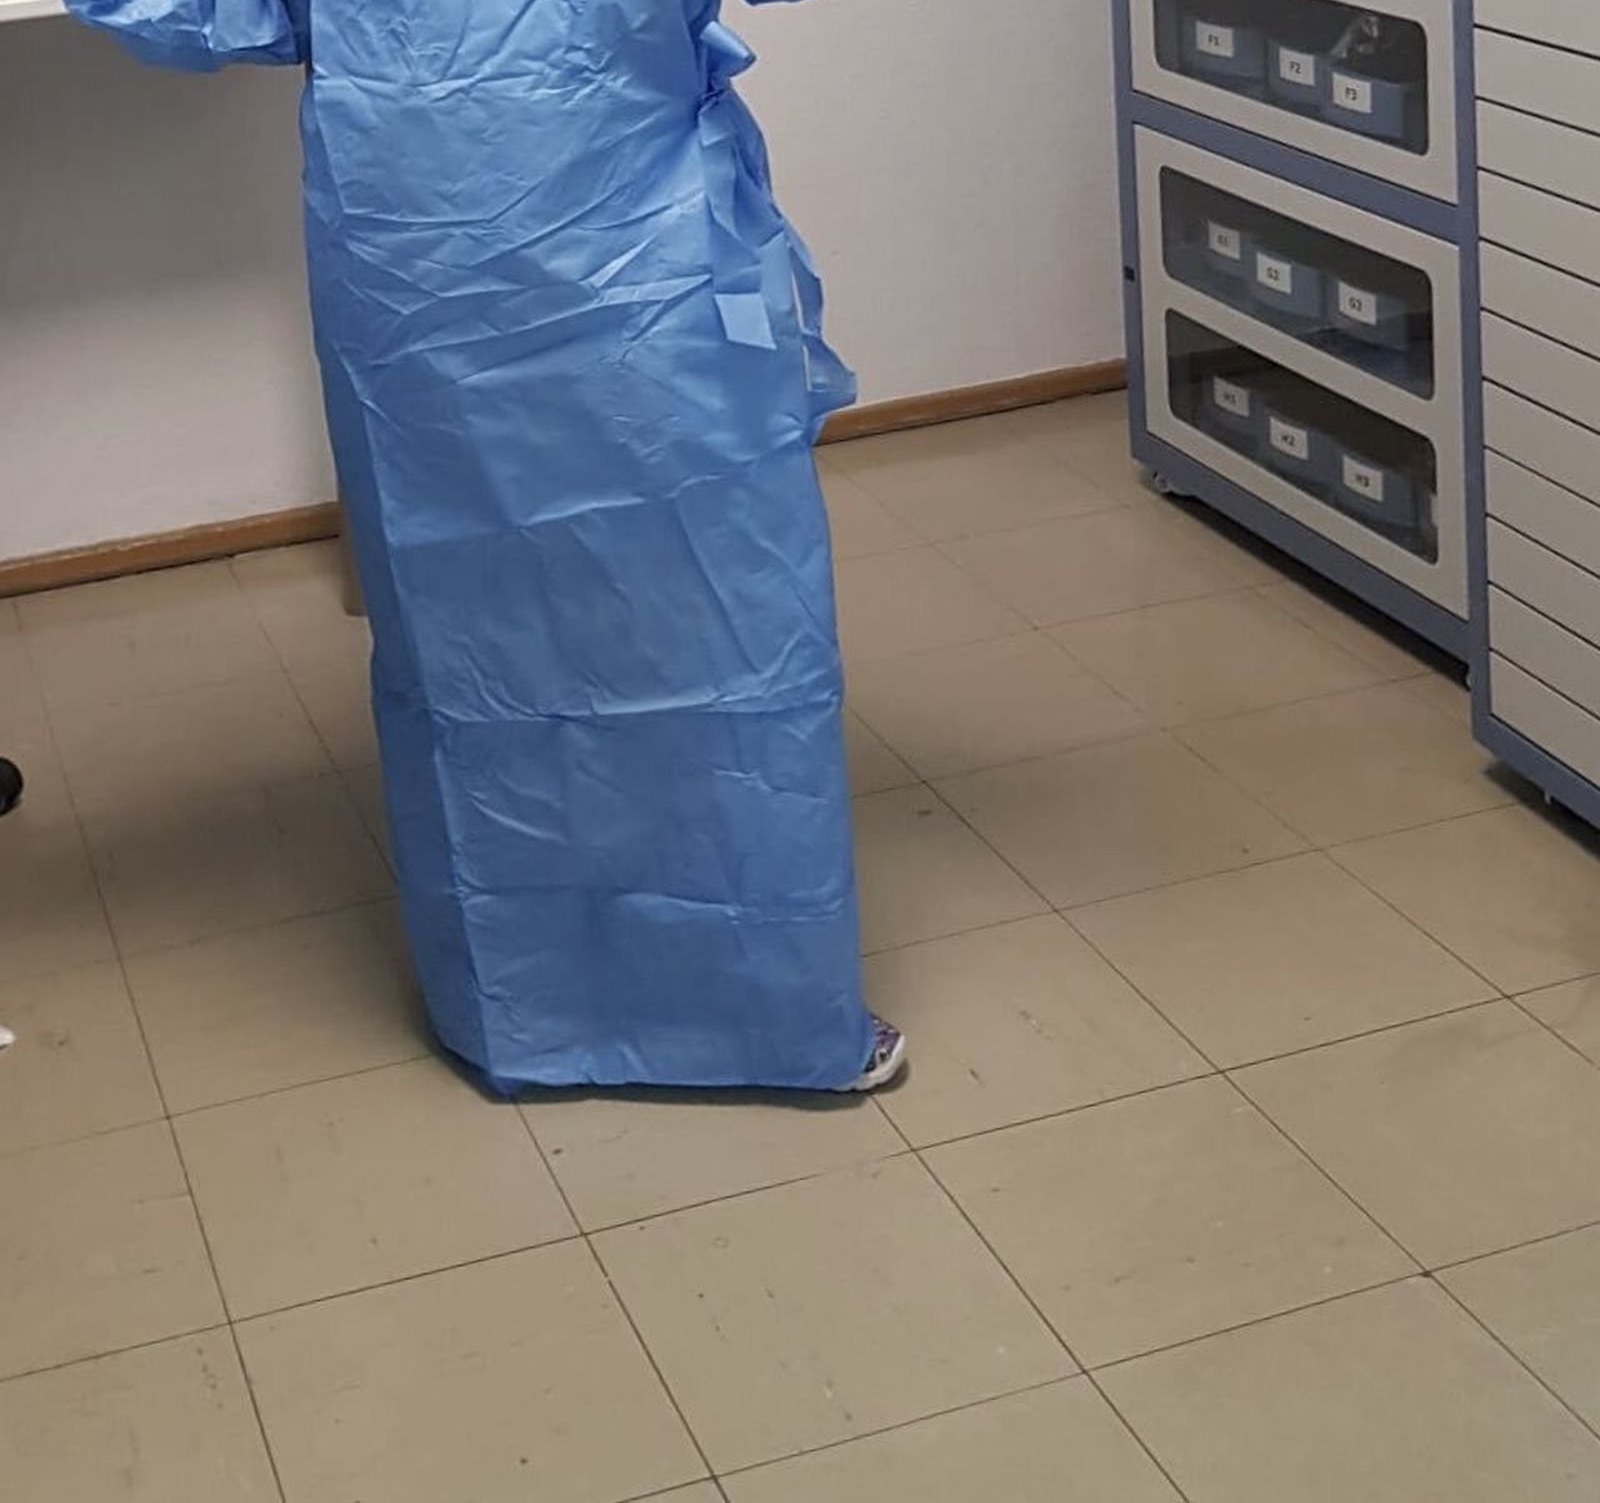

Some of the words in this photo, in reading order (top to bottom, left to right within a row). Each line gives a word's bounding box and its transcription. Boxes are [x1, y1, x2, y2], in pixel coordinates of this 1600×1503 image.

[1208, 33, 1219, 46] F1
[1289, 61, 1301, 74] F2
[1345, 87, 1357, 100] F3
